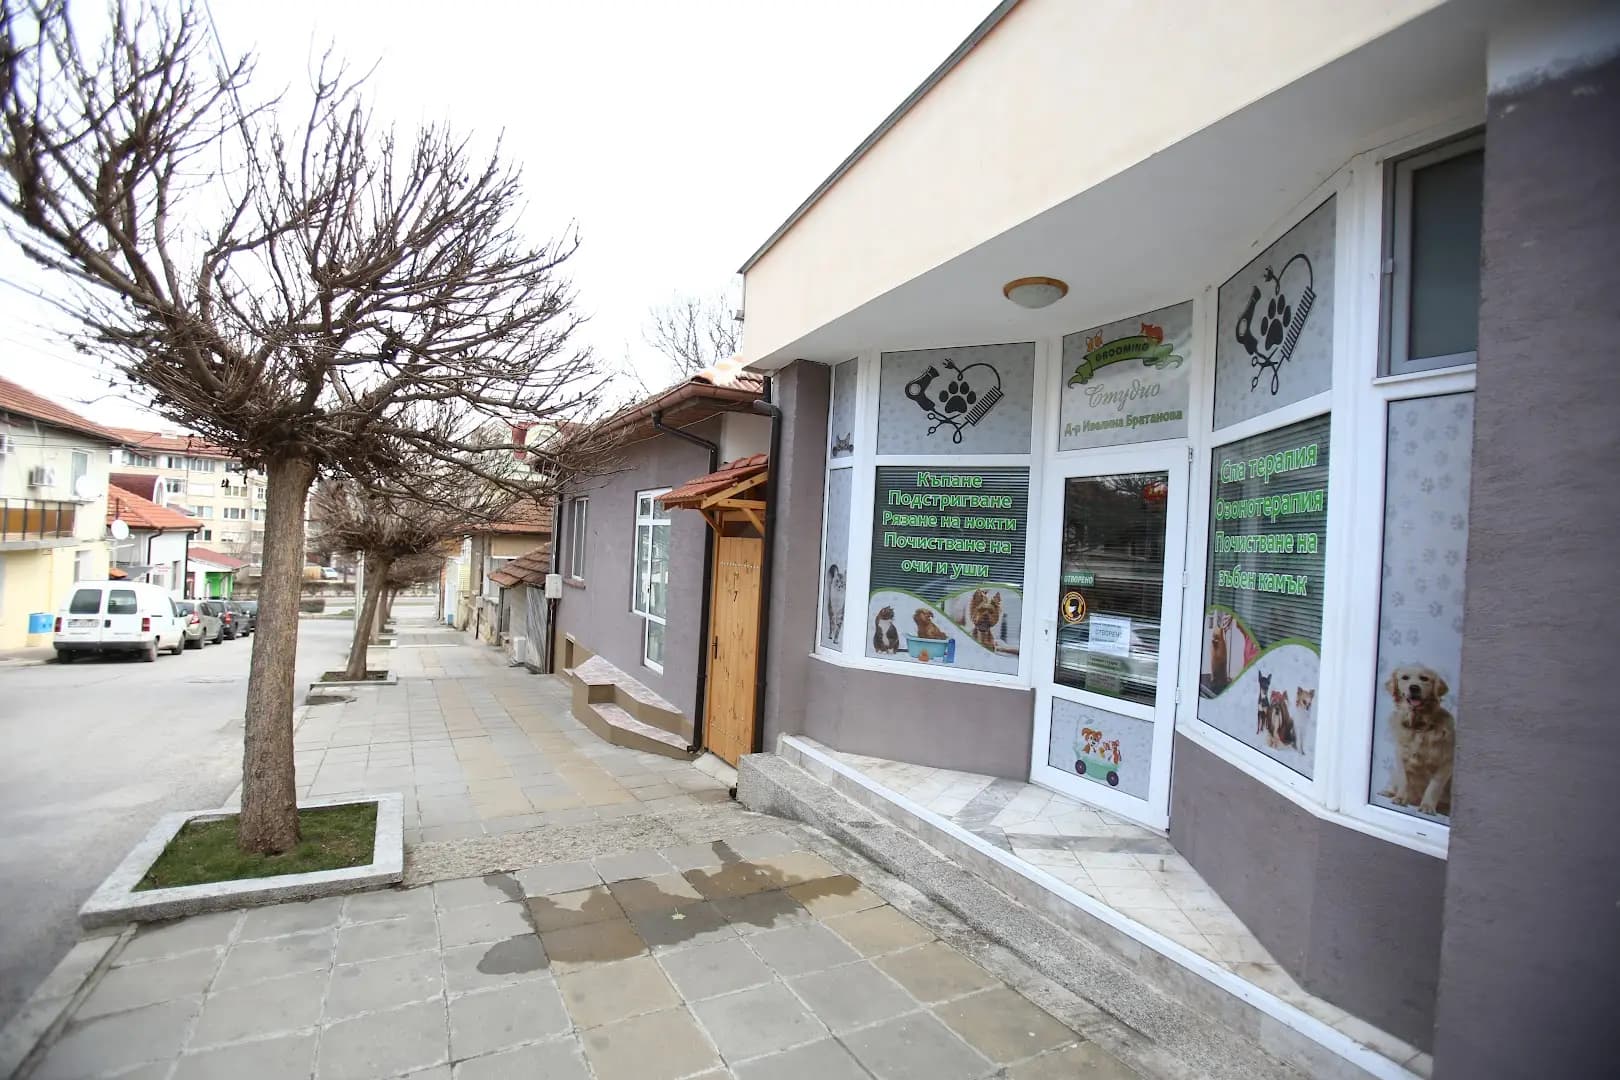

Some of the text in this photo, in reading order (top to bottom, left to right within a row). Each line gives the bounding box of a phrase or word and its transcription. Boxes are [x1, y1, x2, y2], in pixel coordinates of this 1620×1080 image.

[1095, 343, 1149, 361] GROOMING
[1085, 379, 1160, 411] Студио
[1064, 423, 1080, 437] Д-р
[1126, 410, 1183, 428] Братанова
[1221, 444, 1318, 484] Спа терапия
[917, 472, 983, 488] Къпане
[888, 490, 1012, 511] Подстригване
[1215, 490, 1324, 523] Озонотерапия
[882, 511, 1017, 530] Рязане на нокти
[884, 532, 1012, 554] Почистване на
[1214, 531, 1318, 553] Почистване на
[901, 560, 989, 579] очи и уши
[1064, 575, 1093, 585] ОТВОРЕНО
[1218, 564, 1307, 596] зъбен камък
